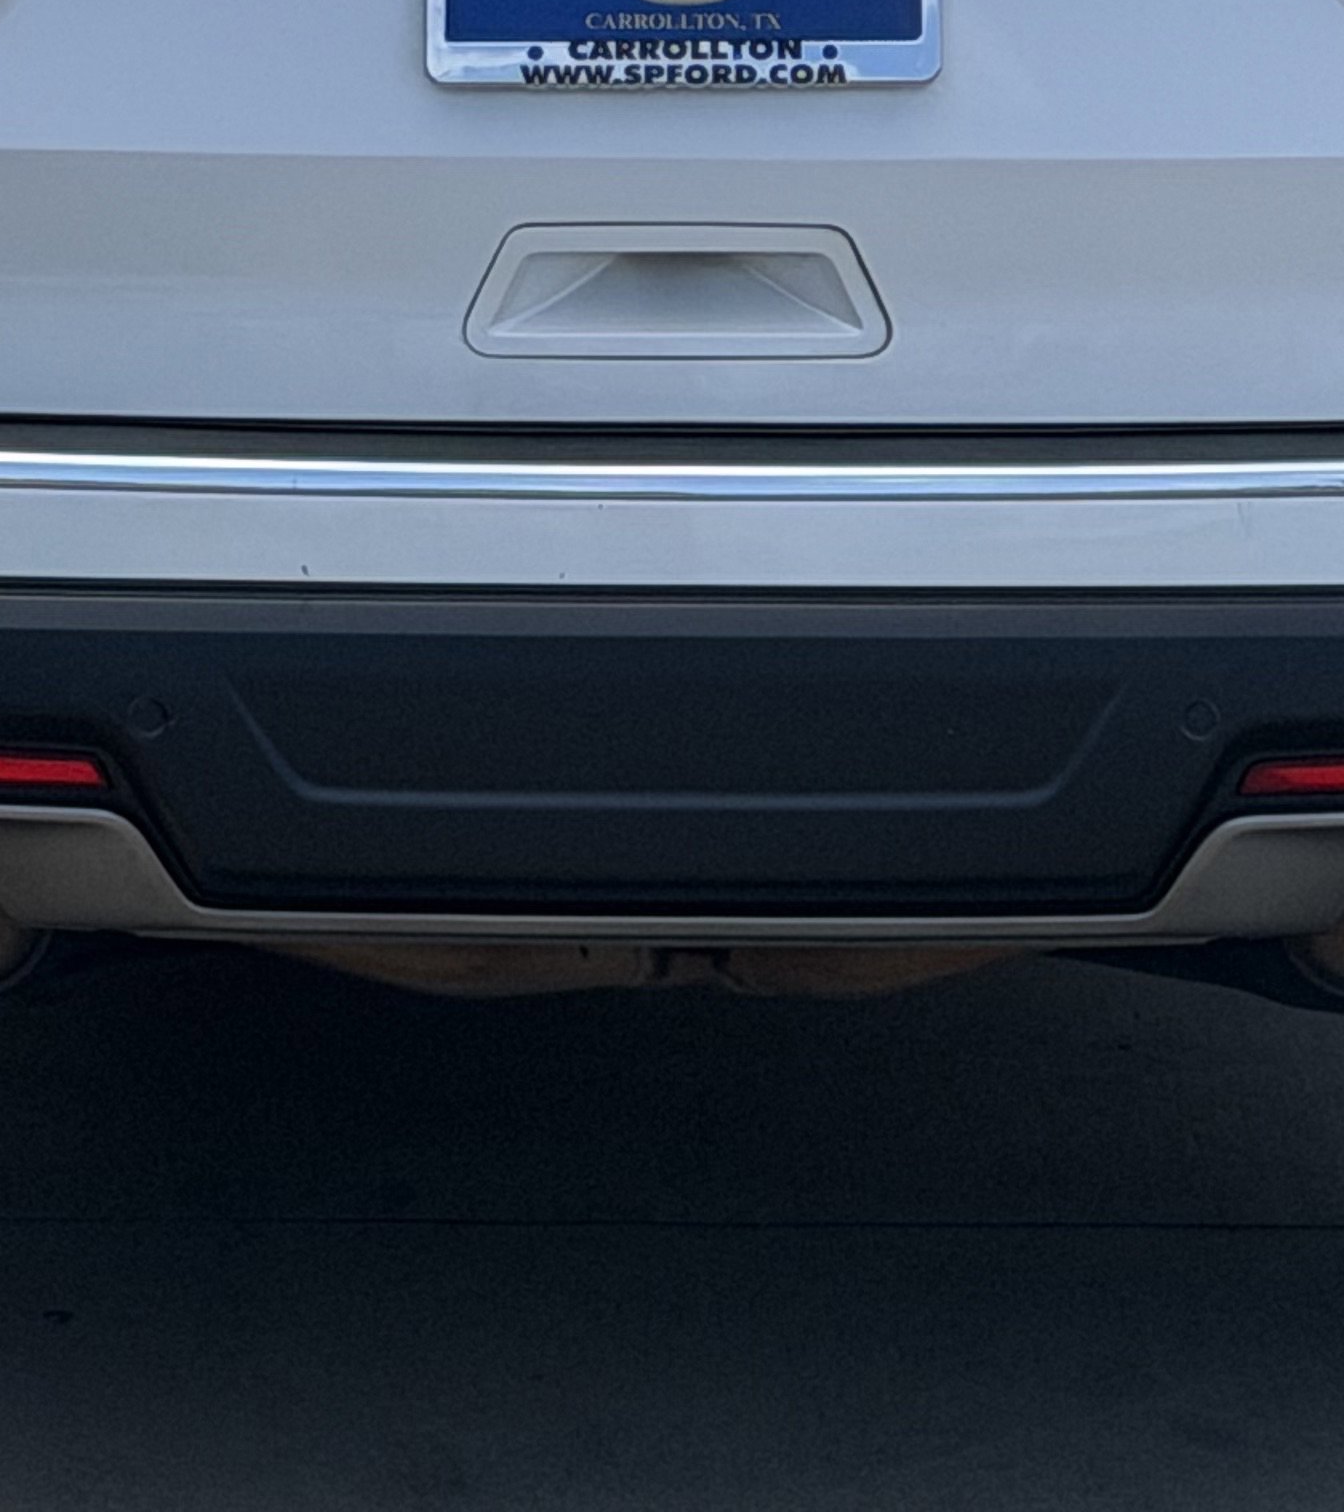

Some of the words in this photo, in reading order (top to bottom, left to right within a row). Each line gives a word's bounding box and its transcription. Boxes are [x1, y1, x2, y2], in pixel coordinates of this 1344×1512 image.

[585, 12, 747, 31] CARROLLTON,
[754, 13, 782, 30] TX
[567, 39, 803, 61] CARROLLTON
[520, 64, 848, 85] WWW.SPFORD.COM
